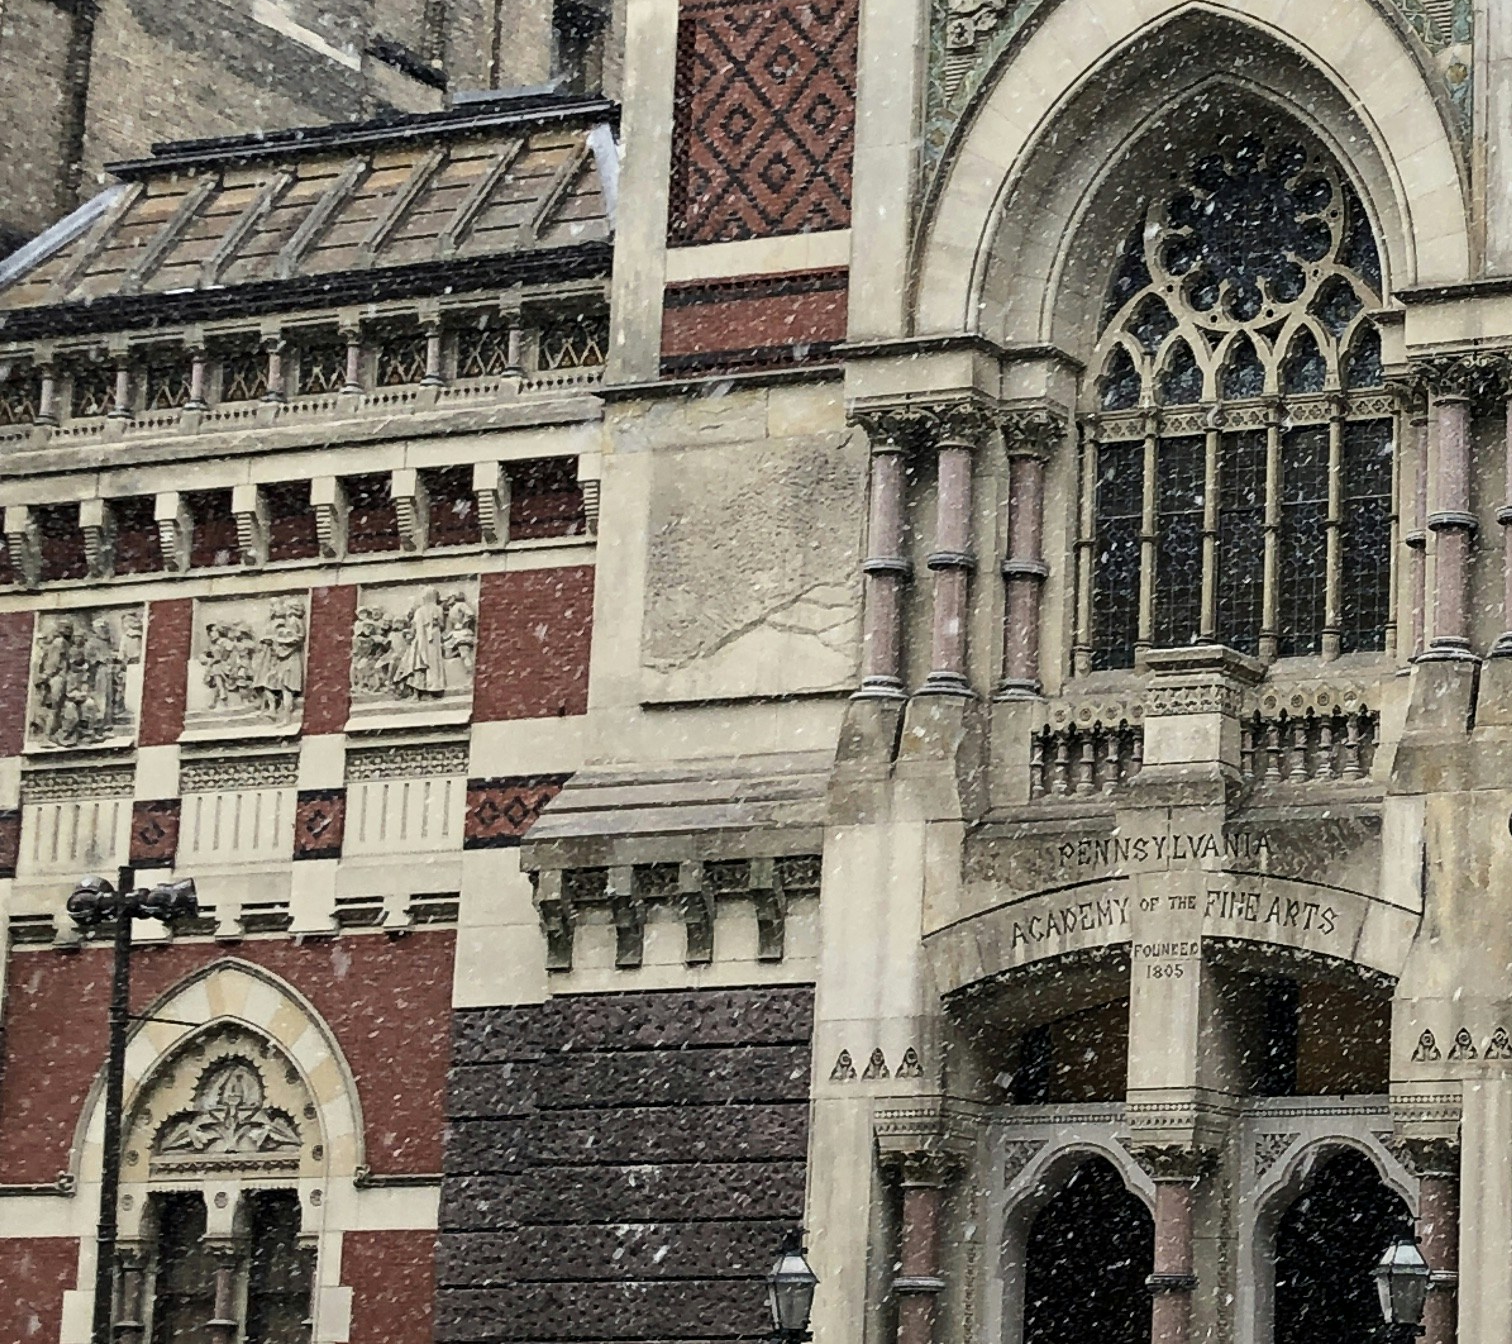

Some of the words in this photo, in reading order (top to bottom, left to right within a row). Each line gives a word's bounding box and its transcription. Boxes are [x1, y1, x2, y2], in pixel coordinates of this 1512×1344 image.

[1058, 832, 1273, 868] PENNSYLVANIA
[1011, 896, 1130, 950] ACADEMY
[1139, 896, 1160, 912] OF
[1168, 895, 1197, 911] THE
[1203, 890, 1261, 922] FINE
[1264, 896, 1339, 936] ARTS
[1146, 963, 1184, 979] 1805
